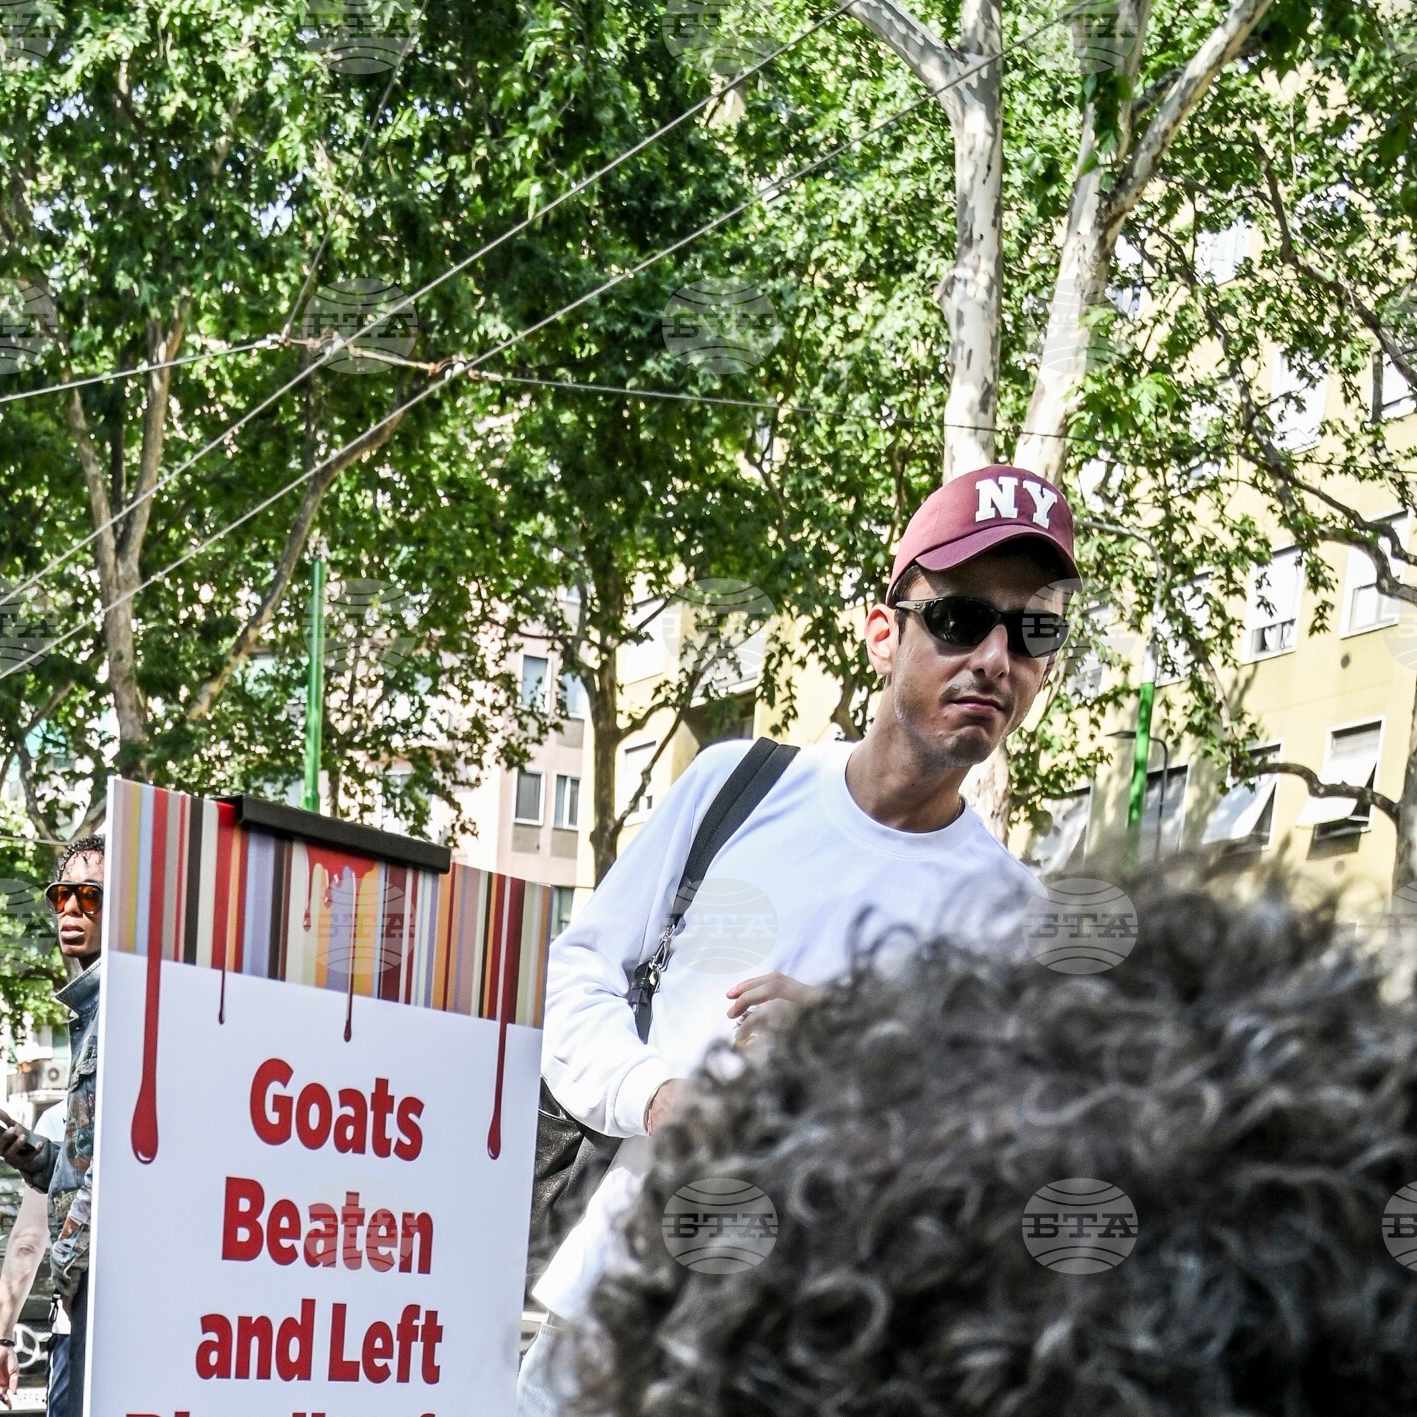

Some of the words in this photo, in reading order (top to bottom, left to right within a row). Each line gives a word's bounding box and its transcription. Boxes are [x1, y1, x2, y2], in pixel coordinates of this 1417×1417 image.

[975, 476, 1058, 529] NY
[249, 1057, 425, 1162] Goats
[221, 1176, 434, 1275] Beaten
[195, 1298, 317, 1382] and
[327, 1302, 444, 1385] Left
